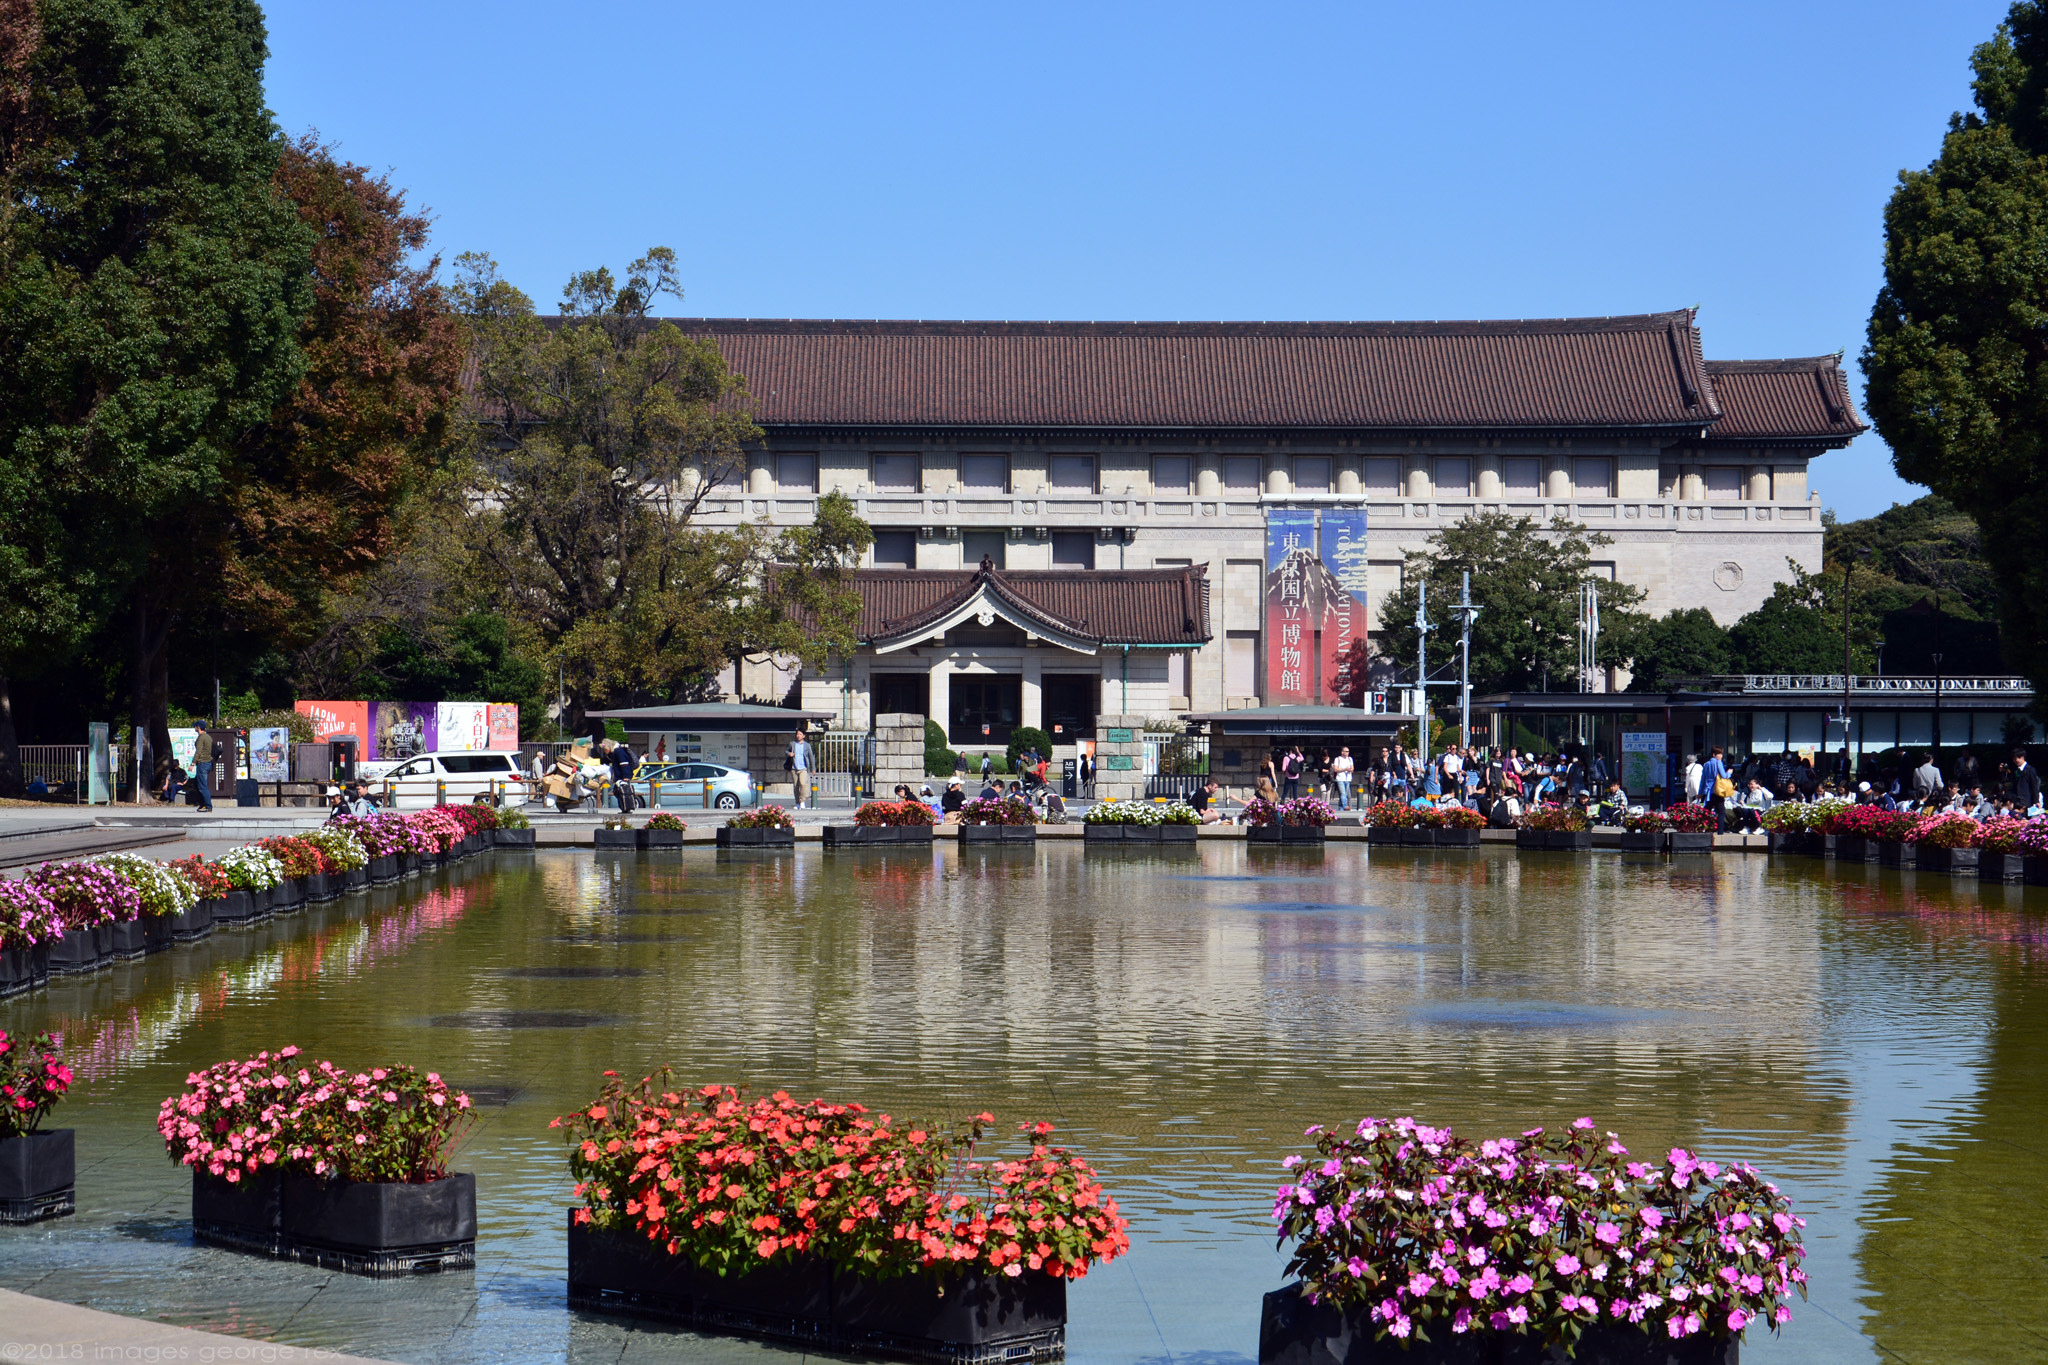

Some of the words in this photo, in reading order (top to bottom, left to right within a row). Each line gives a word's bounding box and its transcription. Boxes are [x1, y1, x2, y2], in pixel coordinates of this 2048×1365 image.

[1337, 525, 1351, 577] TOKYO
[1281, 531, 1301, 691] 東京国立博物館
[1337, 581, 1351, 657] NATIONAL
[1337, 662, 1351, 708] MUSEU
[1744, 675, 1858, 689] 東京国立博物館
[1867, 679, 1912, 690] TOKYO
[1914, 679, 1982, 690] NATIONAL
[1984, 679, 2031, 690] MUSEU
[310, 705, 337, 723] JAPAN
